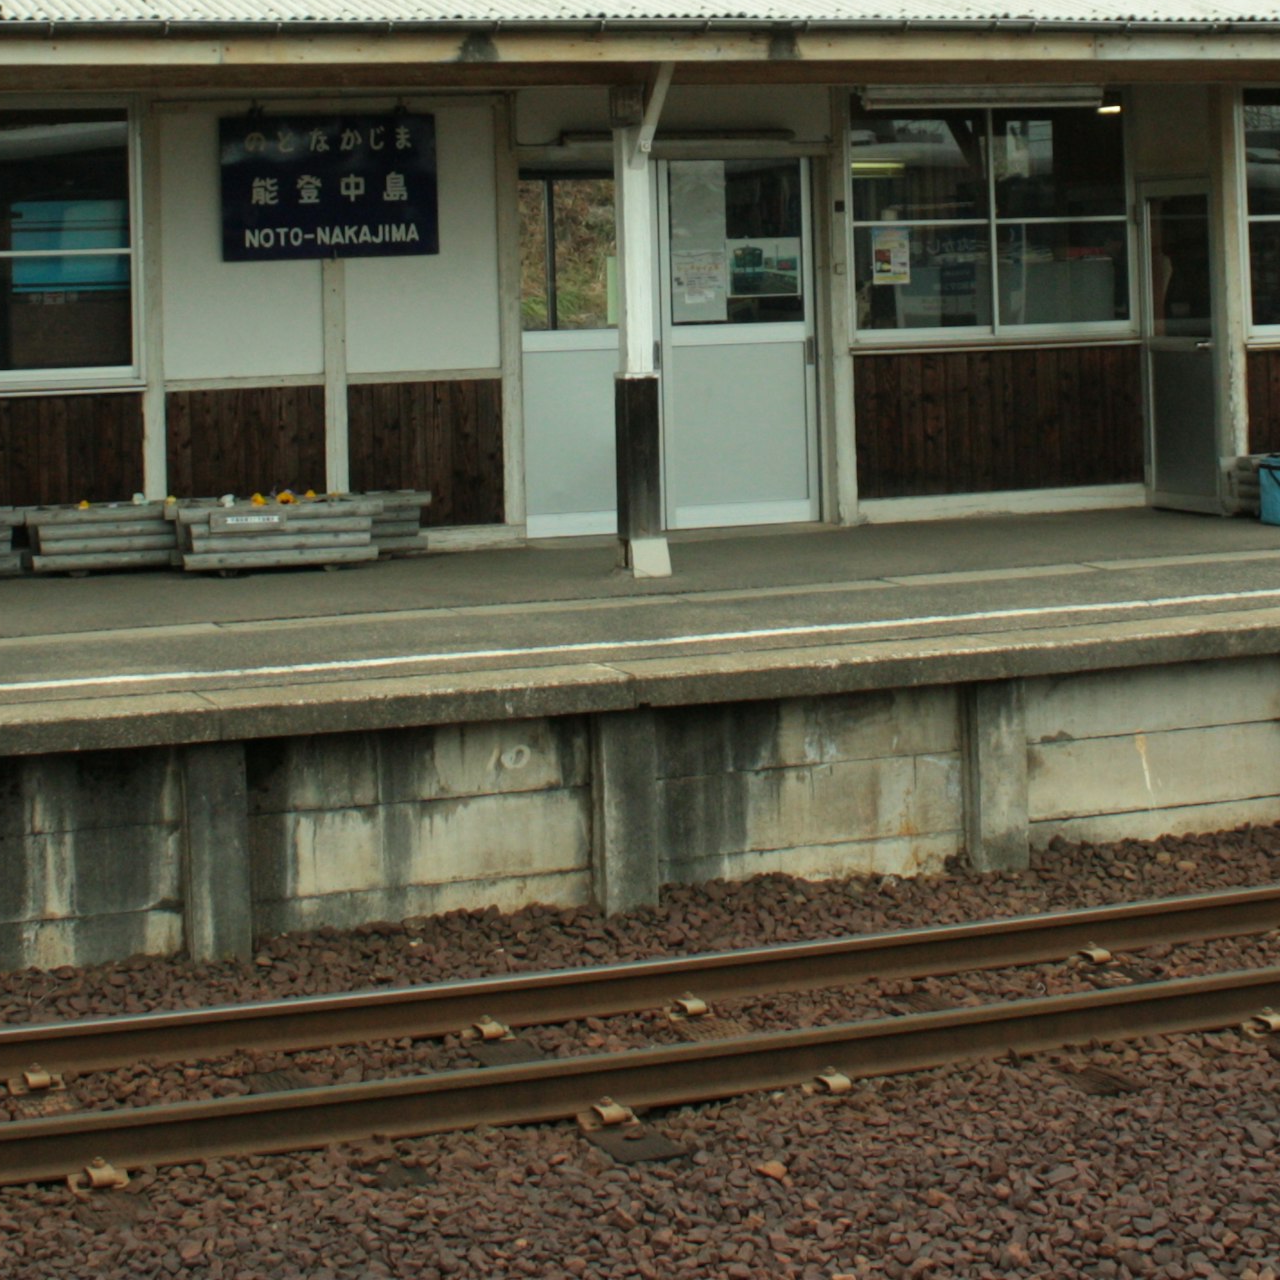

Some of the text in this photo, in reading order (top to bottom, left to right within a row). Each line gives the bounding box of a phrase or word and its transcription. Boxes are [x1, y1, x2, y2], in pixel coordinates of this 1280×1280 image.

[244, 125, 412, 153] のとなかじま
[251, 171, 408, 205] 能登中島
[245, 223, 419, 248] NOTO-NAKAJIMA
